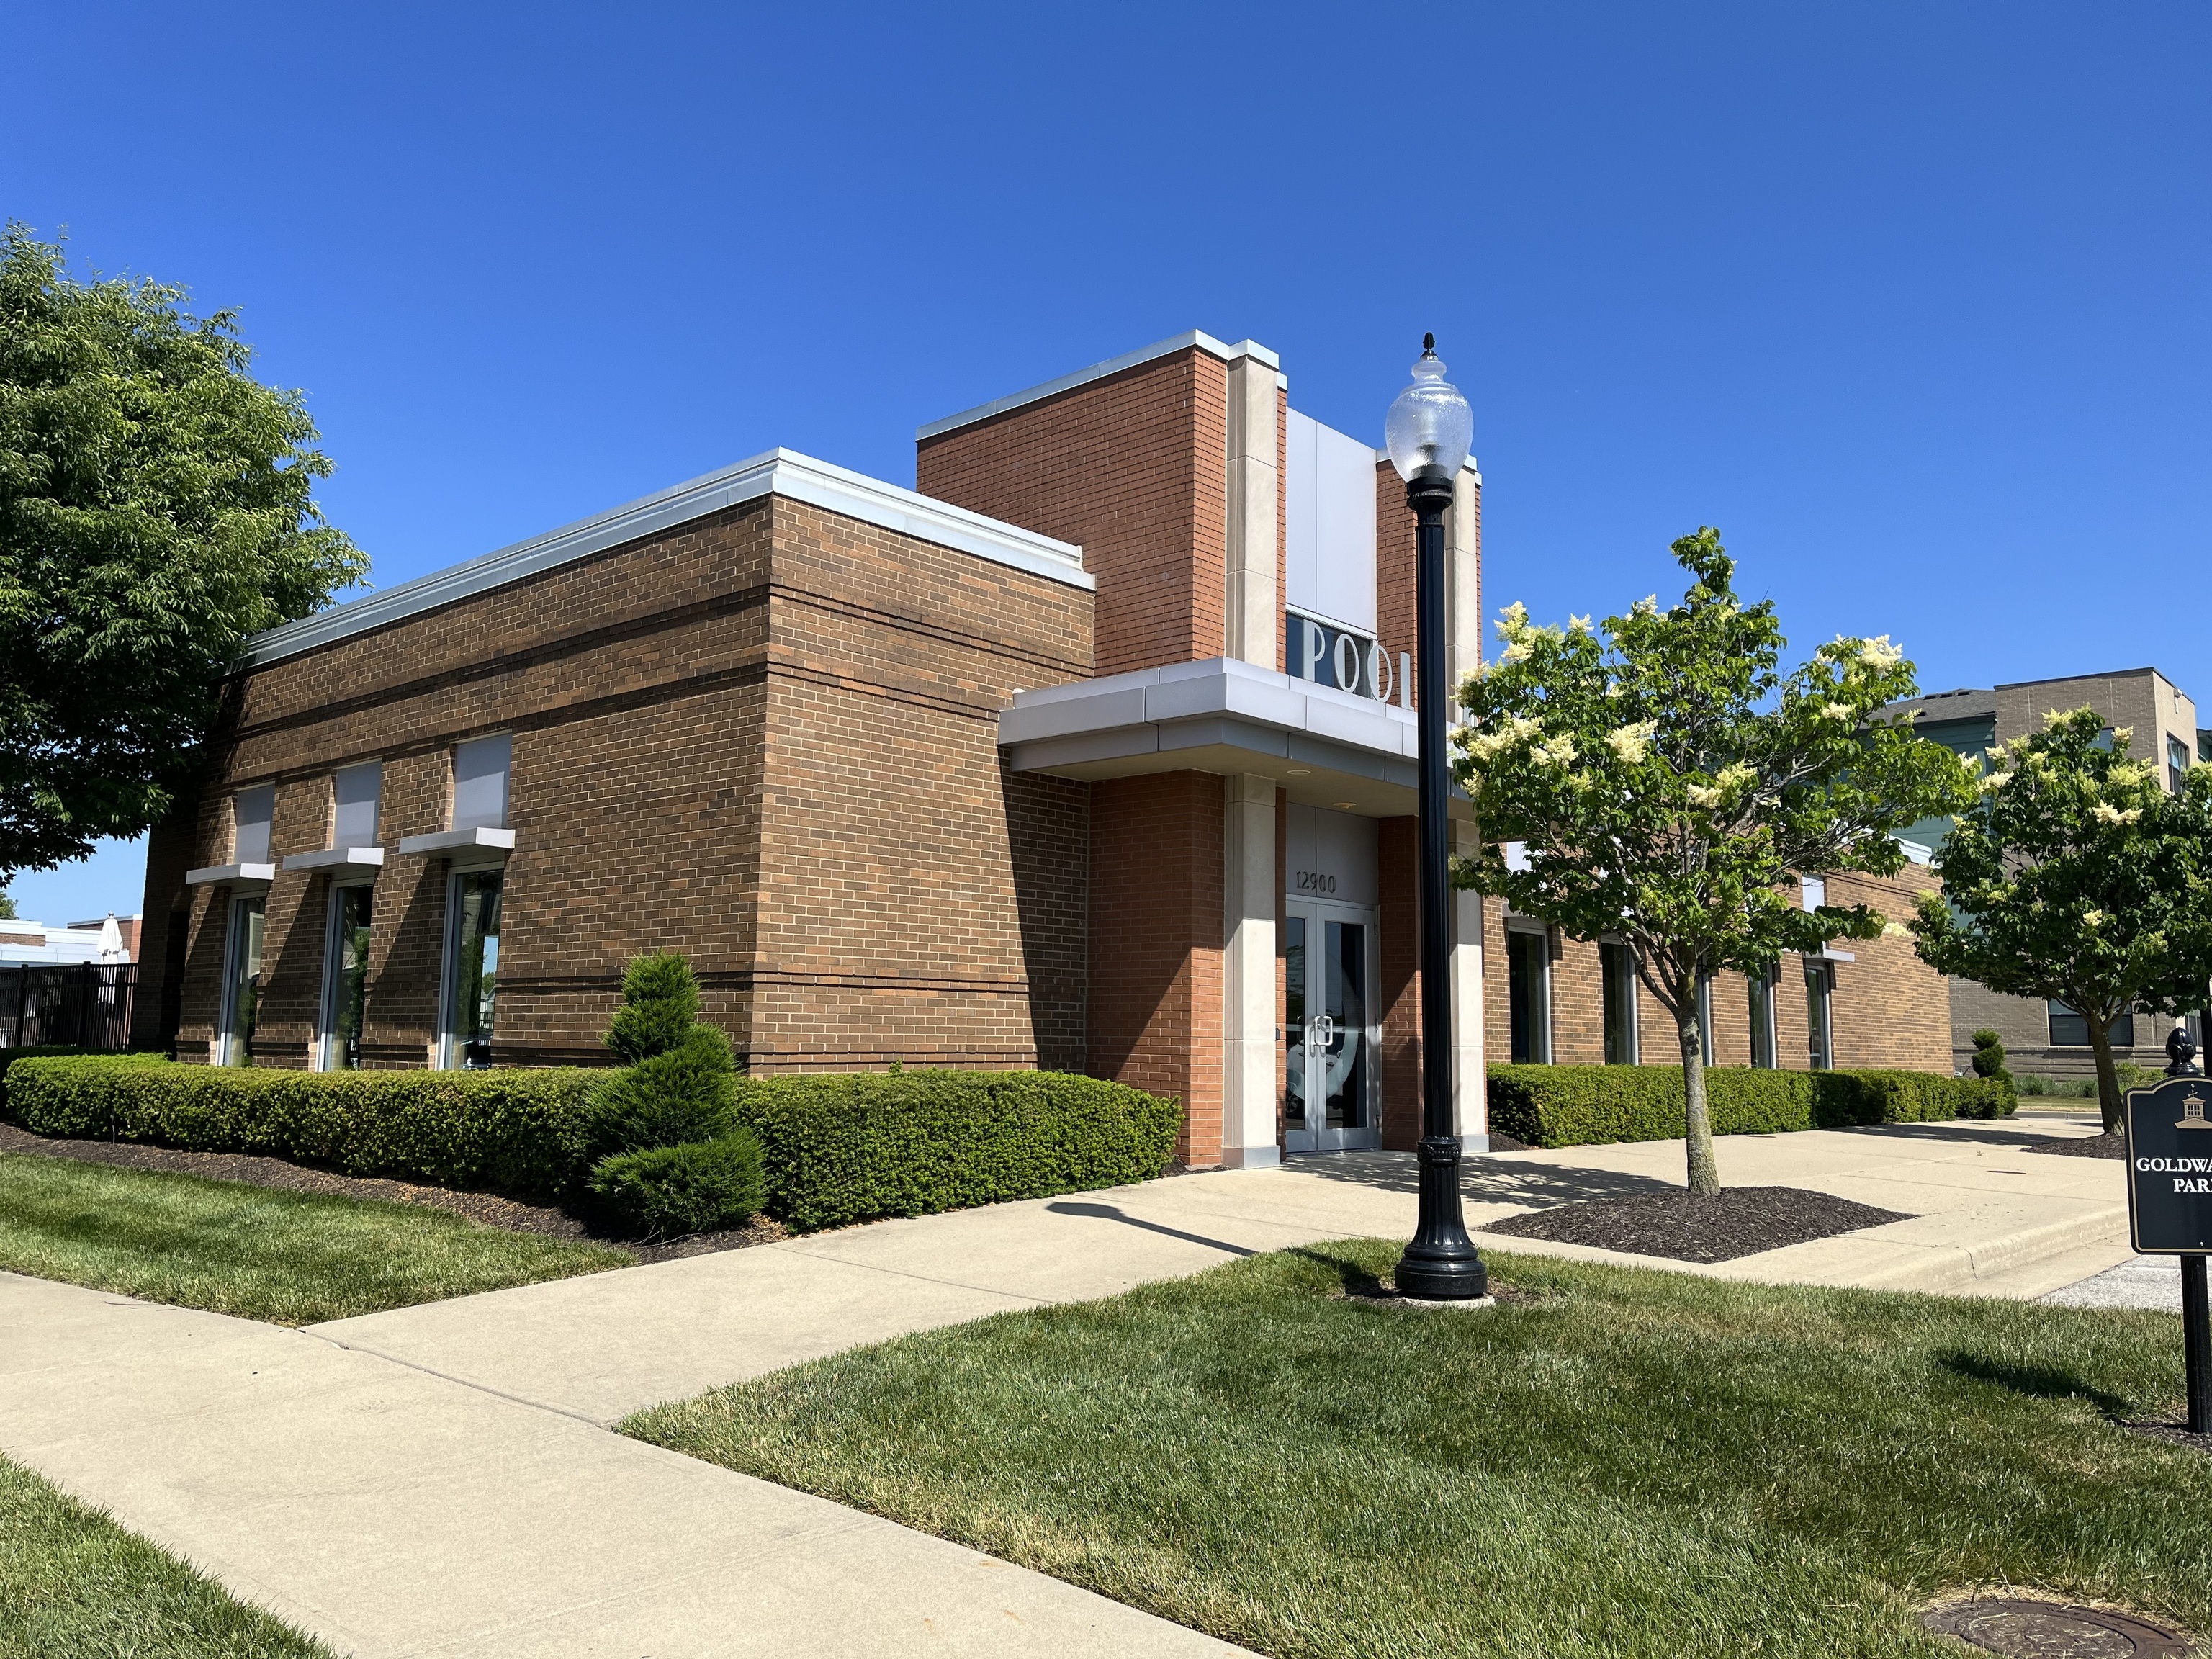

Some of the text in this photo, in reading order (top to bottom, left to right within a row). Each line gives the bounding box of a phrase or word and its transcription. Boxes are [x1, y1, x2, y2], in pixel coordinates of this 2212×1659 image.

[1304, 619, 1415, 711] POOL
[1296, 871, 1336, 893] 12900
[2173, 1178, 2212, 1192] PAR
